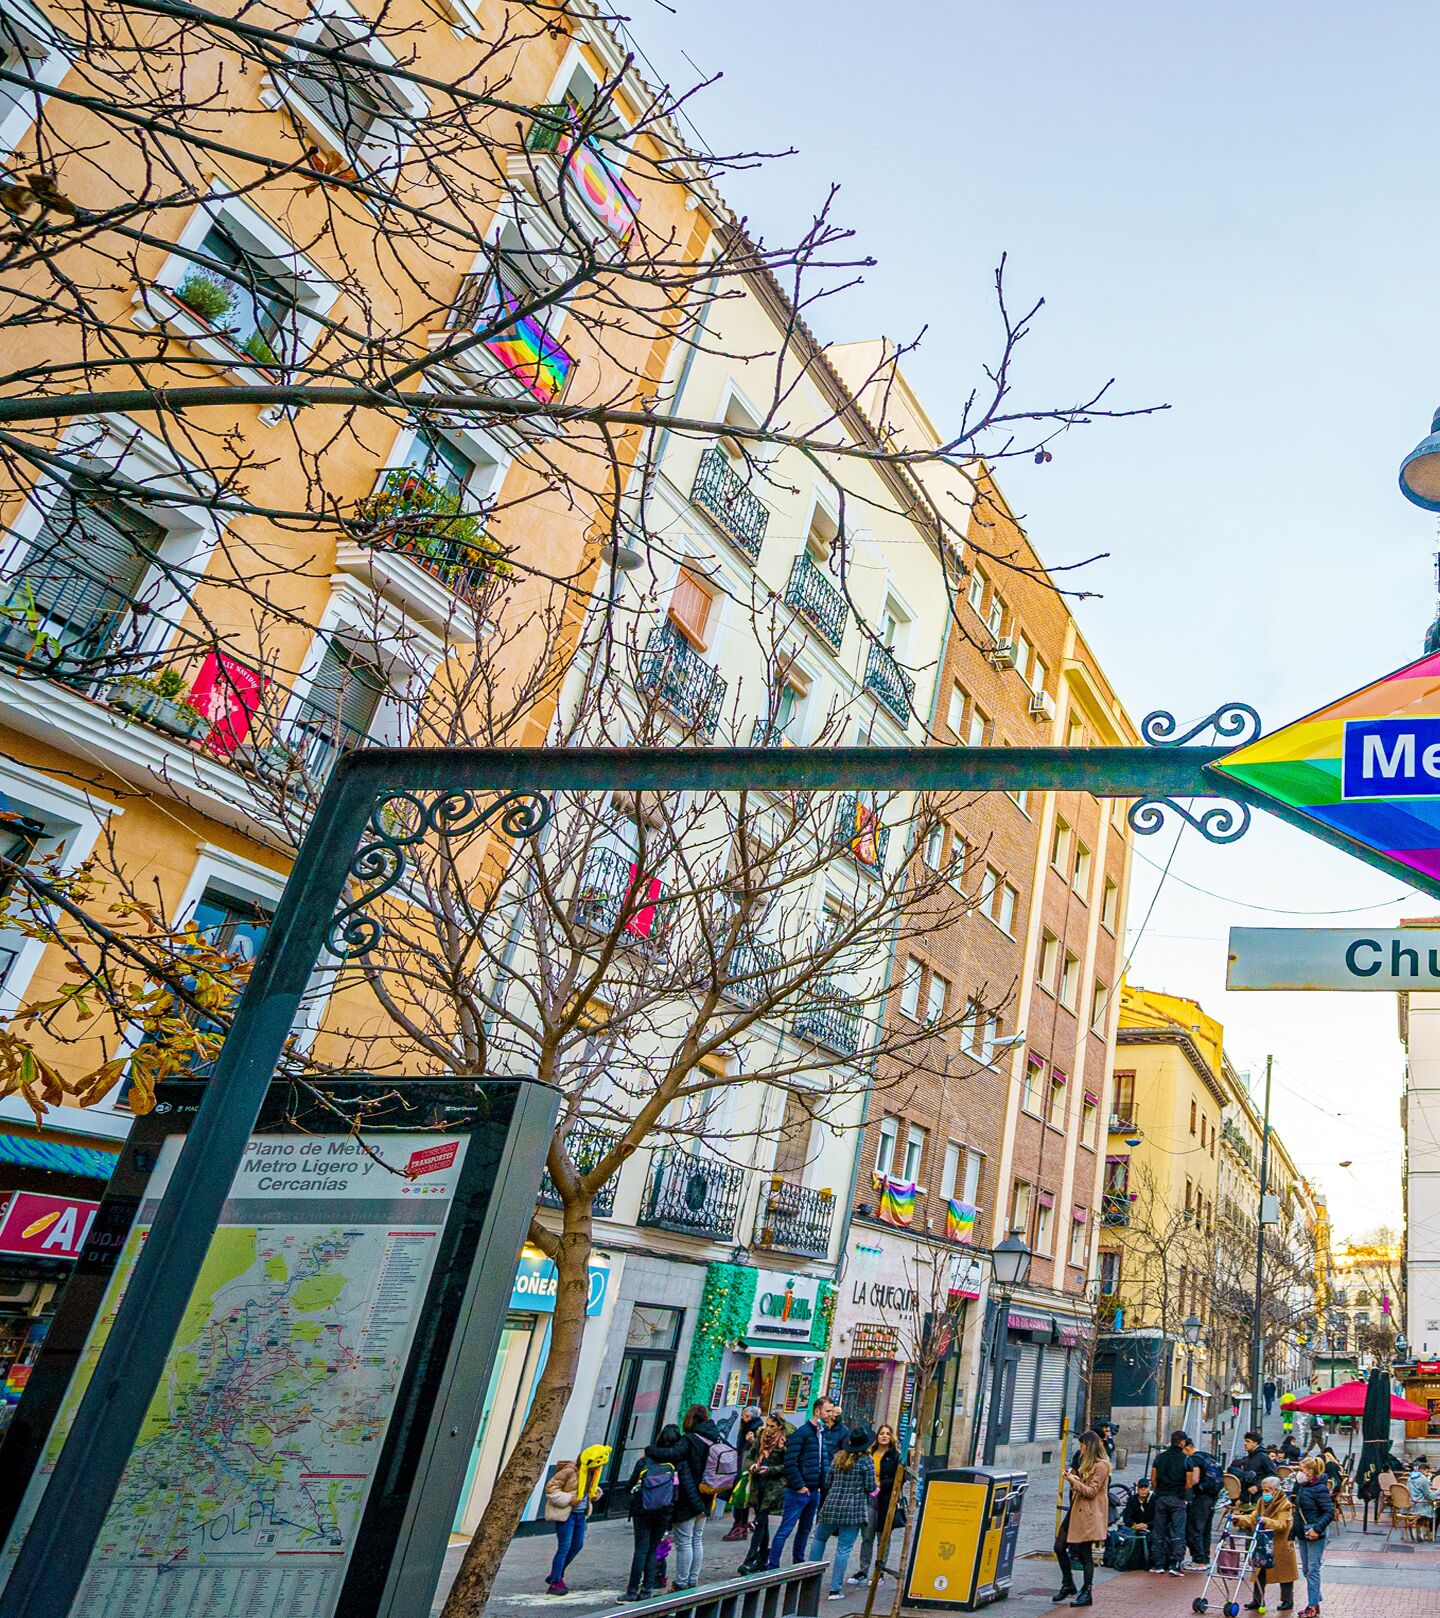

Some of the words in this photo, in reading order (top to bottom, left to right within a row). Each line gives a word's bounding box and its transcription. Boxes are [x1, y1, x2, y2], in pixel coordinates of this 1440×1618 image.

[244, 1142, 297, 1156] Plano
[300, 1142, 322, 1156] de
[327, 1142, 385, 1158] Metro,
[243, 1159, 297, 1173] Metro
[302, 1159, 358, 1176] Ligero
[362, 1163, 375, 1176] y
[411, 1151, 454, 1169] TRANSPORTES
[258, 1176, 348, 1191] Cercanías
[852, 1280, 866, 1305] LA
